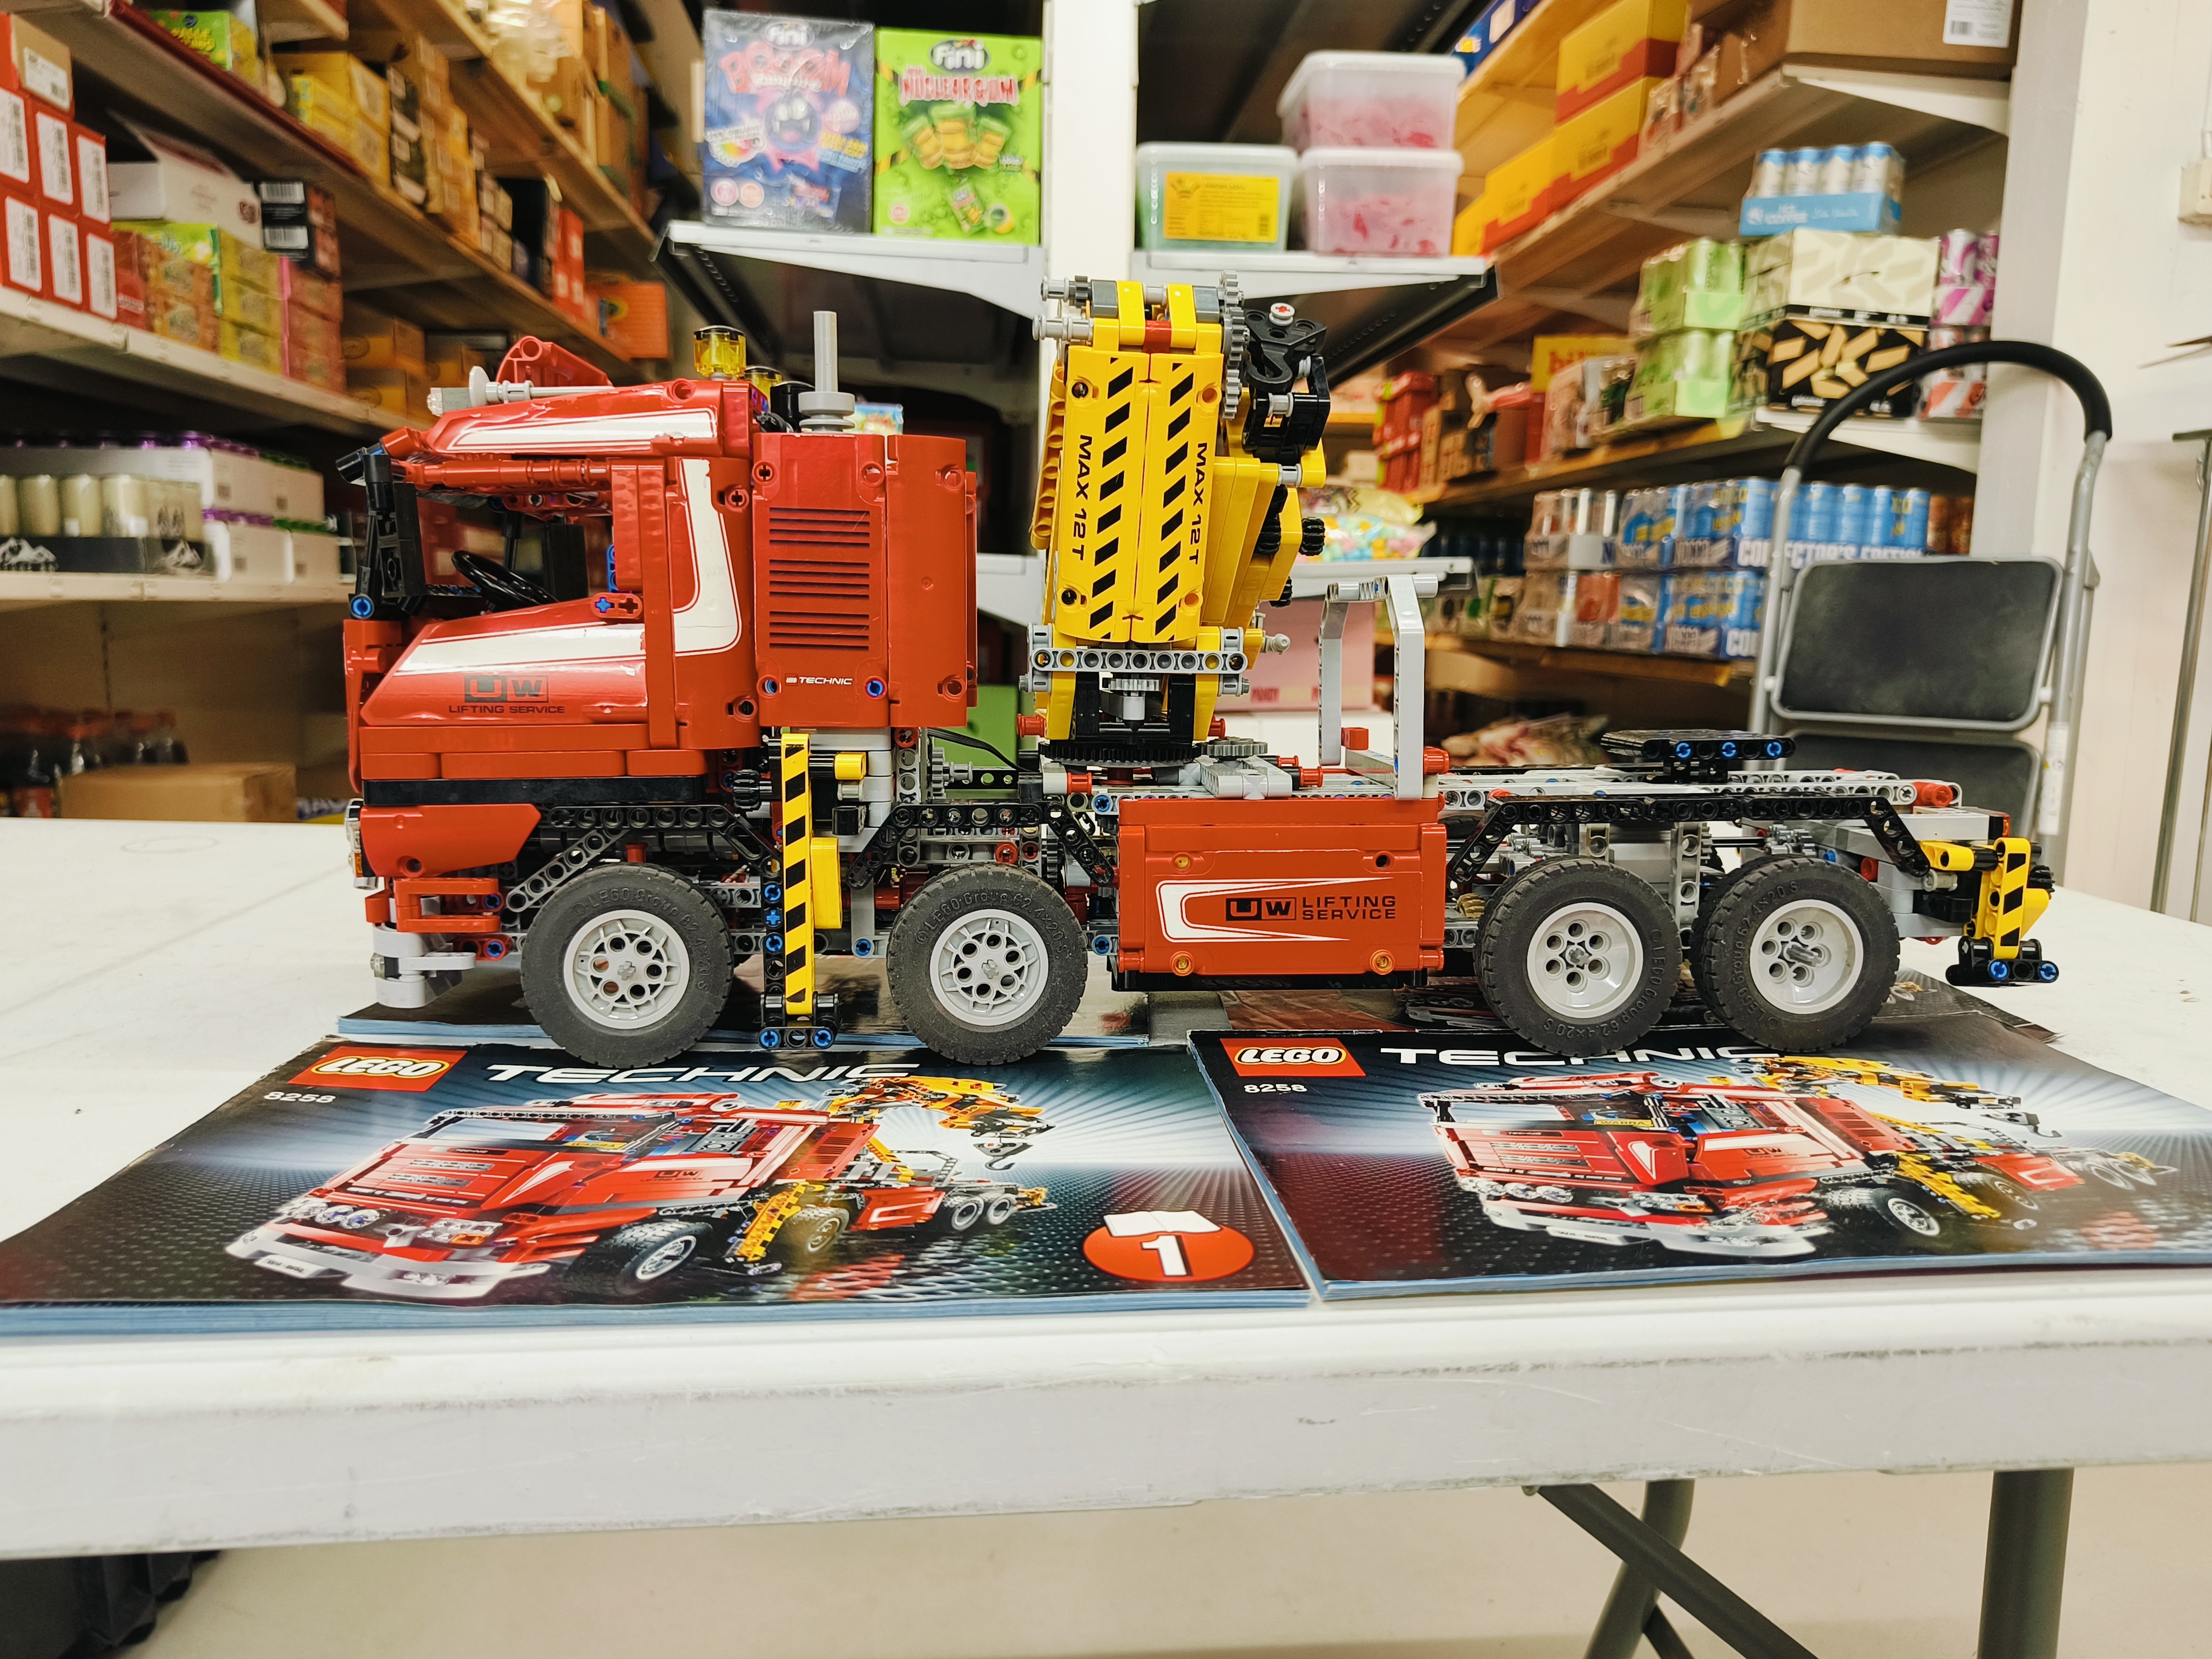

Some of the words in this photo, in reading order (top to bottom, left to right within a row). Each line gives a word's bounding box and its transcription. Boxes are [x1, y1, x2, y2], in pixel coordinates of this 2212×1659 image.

[1076, 435, 1092, 500] MAX
[1193, 442, 1208, 507] MAX
[1073, 508, 1088, 539] 12
[1190, 514, 1202, 545] 12
[799, 677, 853, 685] TECHNIC
[449, 705, 504, 713] LIFTING
[588, 887, 630, 908] LEGO
[635, 888, 679, 918] Group
[924, 896, 961, 930] LEGO
[963, 890, 1010, 906] Group
[1302, 895, 1396, 908] LIFTING
[1302, 908, 1396, 920] SERVICE
[1649, 945, 1667, 986] LEGO
[1736, 986, 1767, 1023] LEGO
[1238, 1047, 1344, 1065] LEGO
[1380, 1046, 1780, 1066] TECHNIC
[316, 1057, 444, 1077] LEGO
[488, 1063, 920, 1084] TECHNIC
[264, 1091, 336, 1104] 8258
[1244, 1083, 1308, 1094] 8258
[1141, 1235, 1188, 1276] 1
